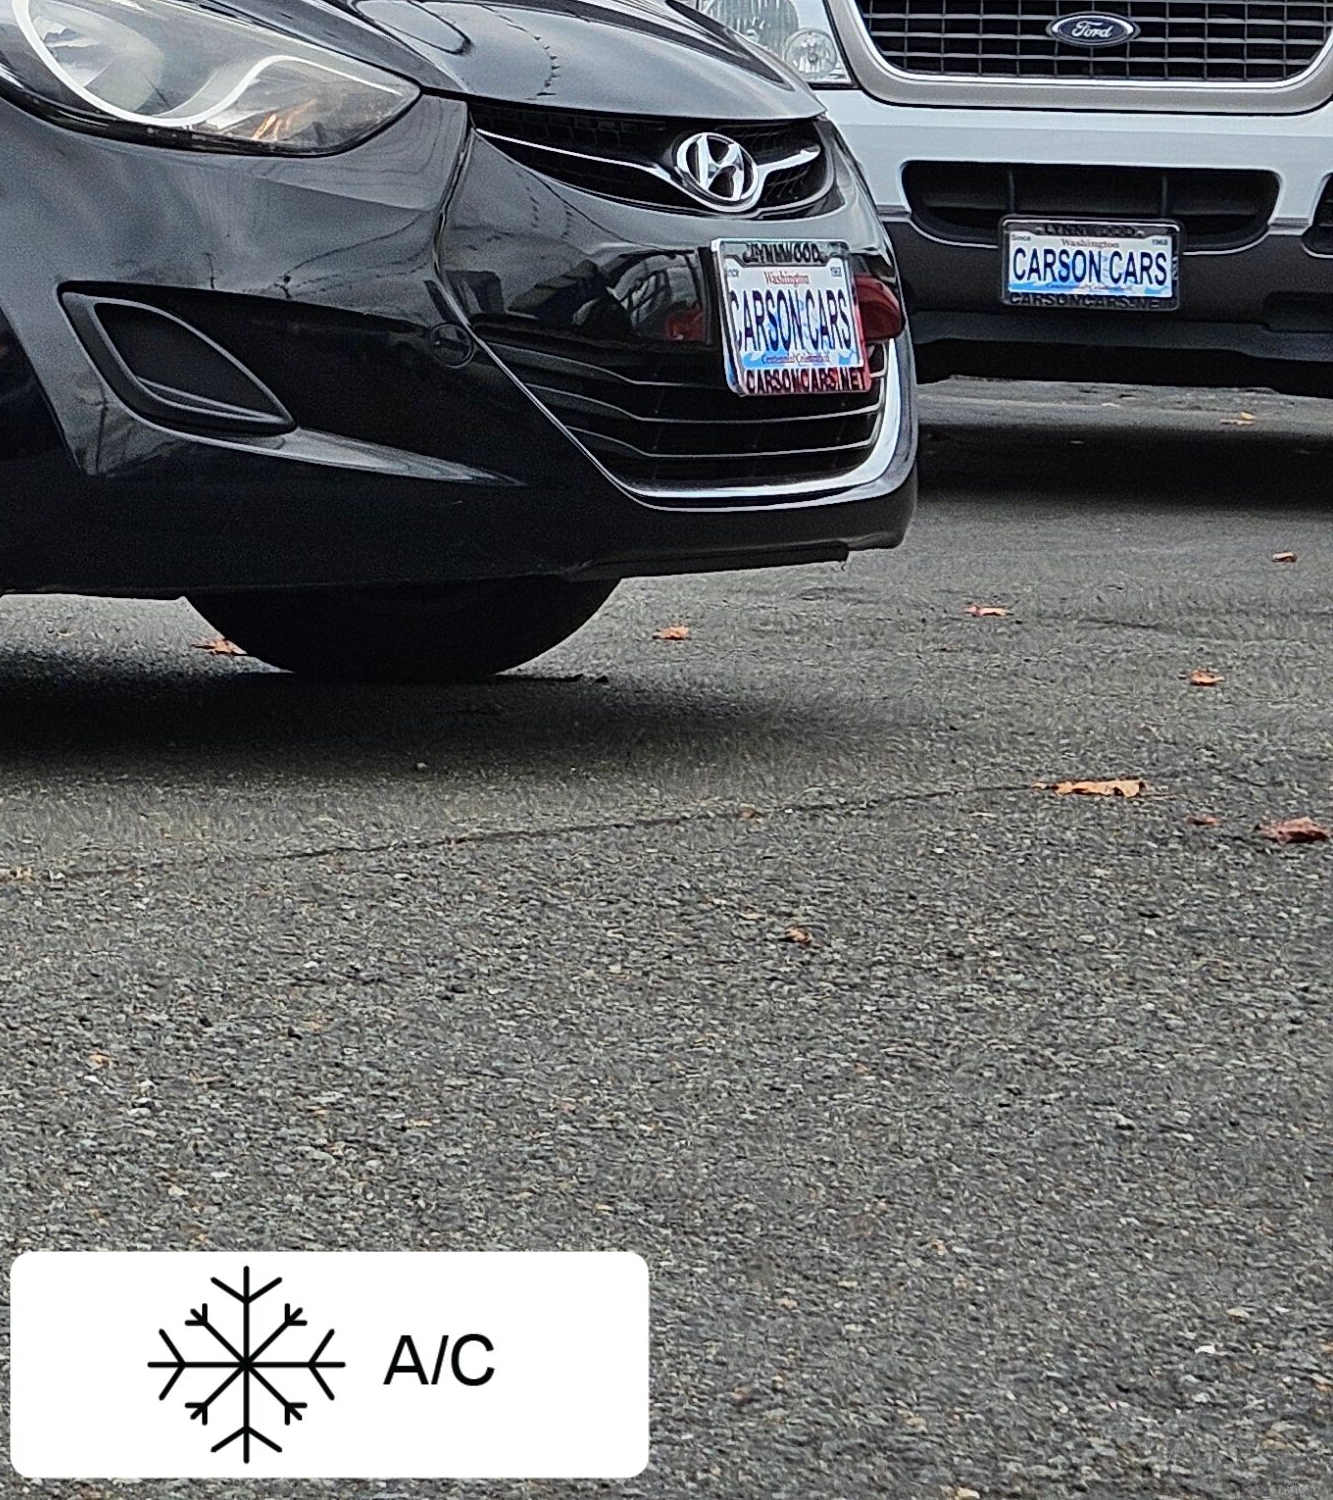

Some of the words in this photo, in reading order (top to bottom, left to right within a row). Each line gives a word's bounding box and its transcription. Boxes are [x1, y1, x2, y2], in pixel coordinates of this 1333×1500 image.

[1071, 20, 1115, 38] Ford
[1061, 238, 1120, 249] Washington
[1013, 247, 1102, 283] CARSON
[1109, 250, 1167, 286] CARS
[764, 270, 810, 287] Washington
[729, 289, 805, 352] CARSON
[805, 288, 852, 351] CARS
